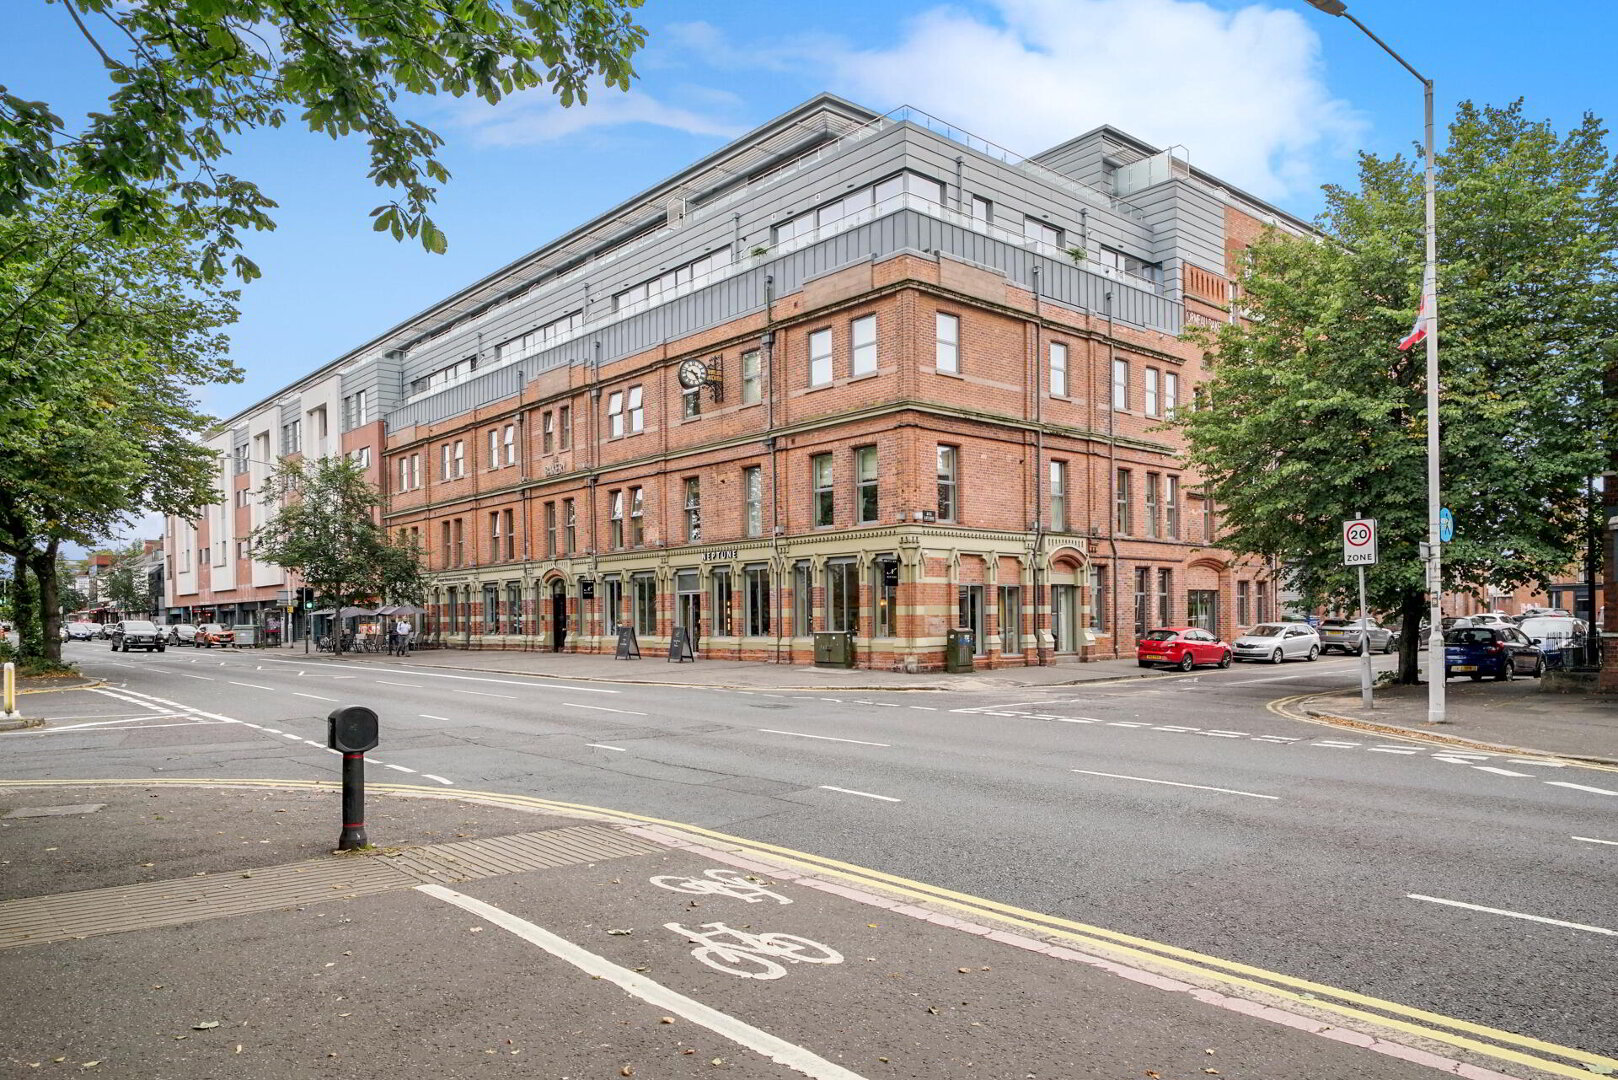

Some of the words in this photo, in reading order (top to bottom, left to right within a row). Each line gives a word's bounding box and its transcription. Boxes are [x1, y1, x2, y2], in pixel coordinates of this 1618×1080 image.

[1350, 529, 1367, 540] 20
[701, 550, 737, 561] NEPTUNE
[1347, 553, 1372, 562] ZONE
